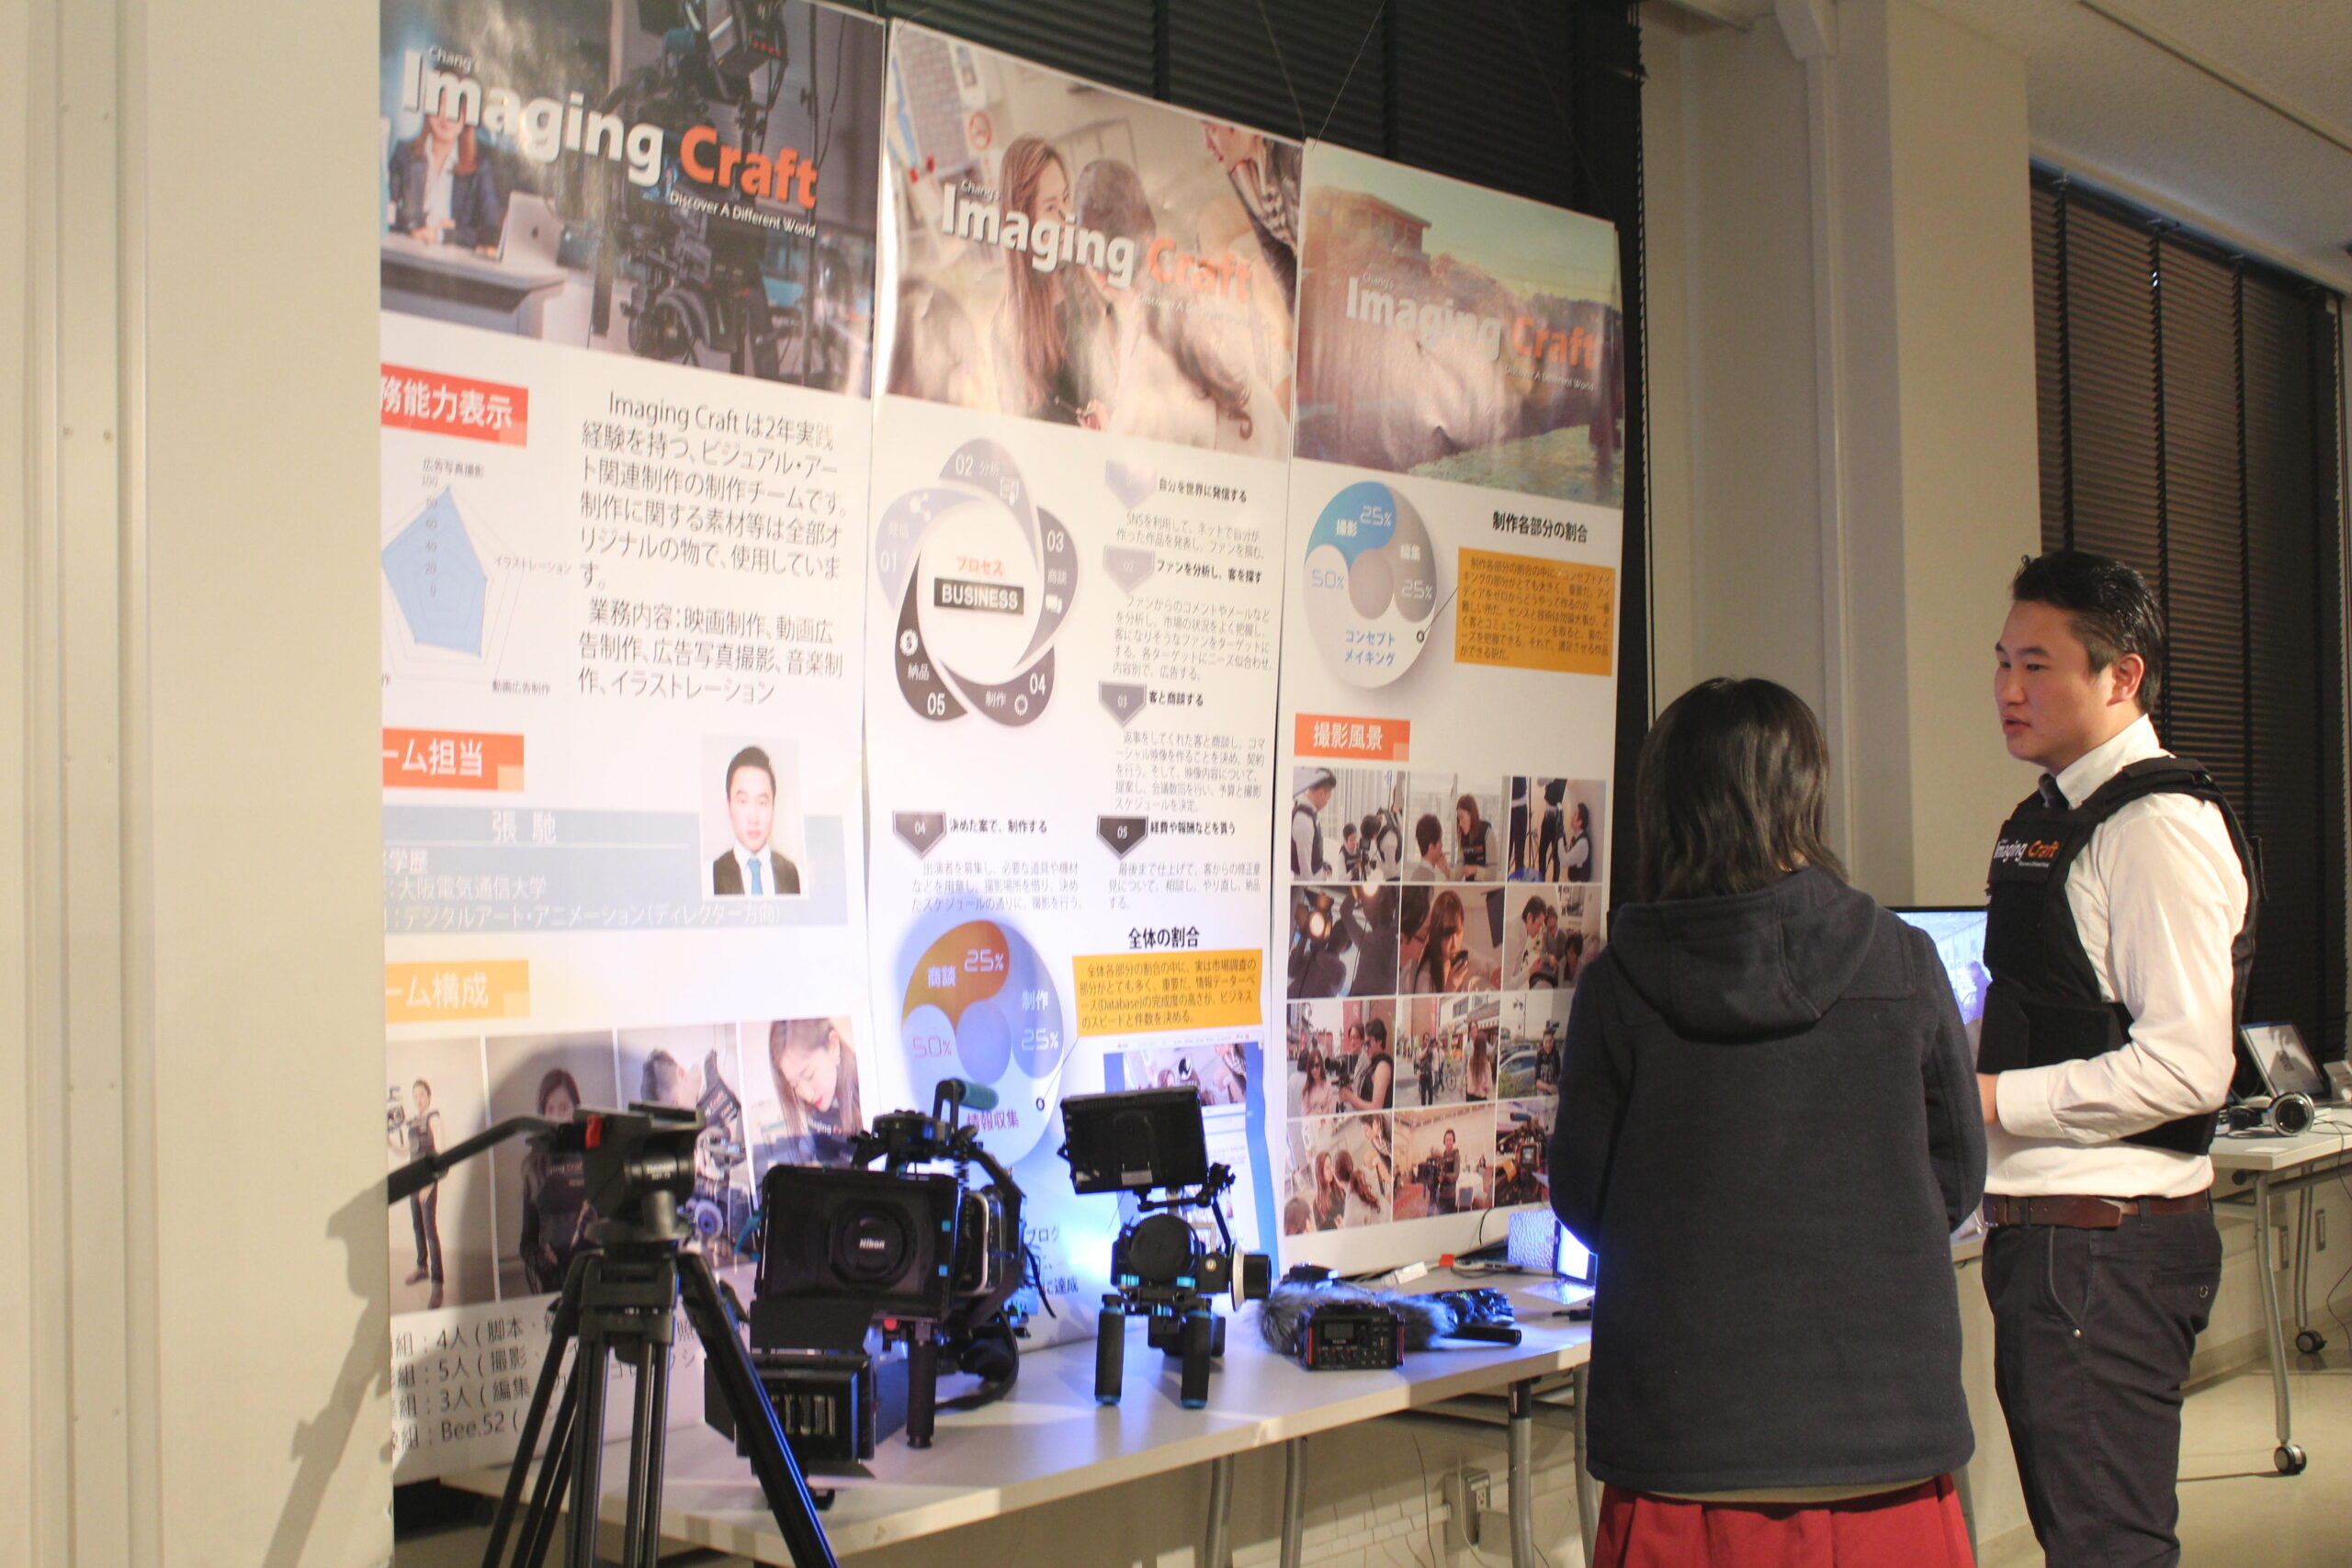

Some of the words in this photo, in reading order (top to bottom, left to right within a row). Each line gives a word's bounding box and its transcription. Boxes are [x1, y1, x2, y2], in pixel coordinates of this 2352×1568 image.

[402, 50, 665, 187] Imaging
[679, 124, 818, 209] Craft
[670, 189, 718, 215] Discover
[719, 203, 731, 219] A
[732, 205, 781, 231] Different
[782, 216, 817, 239] World
[941, 181, 1136, 290] Imaging
[1146, 235, 1251, 302] Craft
[1346, 276, 1502, 362] Imaging
[1511, 314, 1596, 370] Craft
[380, 374, 514, 430] 務能力表示
[609, 390, 690, 433] Imaging
[695, 404, 737, 434] Craft
[745, 411, 834, 451] は2年実践
[582, 419, 838, 479] 経験を持つ、ビジュアル・アー
[955, 453, 974, 477] 02
[583, 455, 846, 517] ト関連制作の制作チームです。
[1159, 477, 1248, 503] 自分を世界に発信する
[581, 491, 842, 548] 制作に関する素材等は全部オ
[1359, 504, 1393, 528] 25%
[1492, 510, 1589, 544] 制作各部分の割合
[581, 525, 841, 581] リジナルの物で、使用していま
[1046, 530, 1065, 553] 03
[879, 550, 899, 573] 01
[956, 555, 1004, 576] プロセス
[580, 560, 606, 591] す。
[1311, 568, 1345, 590] 50%
[941, 583, 1019, 610] BUSINESS
[1401, 580, 1433, 601] 25%
[1345, 629, 1396, 648] コンセプト
[579, 631, 843, 680] 告制作、広告写真撮影、音楽制
[1344, 649, 1396, 668] メイキング
[907, 661, 930, 682] 納品
[1028, 671, 1047, 695] 04
[578, 665, 775, 705] 作、イラストレーション
[926, 692, 946, 716] 05
[985, 691, 1007, 708] 制作
[1148, 691, 1204, 707] 客と商談する
[1312, 720, 1385, 750] 撮影風景
[382, 738, 483, 777] ーム担当
[914, 820, 926, 836] 04
[950, 818, 1047, 834] 決めた案で、制作する
[1116, 825, 1129, 840] 05
[1128, 925, 1201, 950] 全体の割合
[964, 948, 1004, 973] 25%
[927, 964, 956, 988] 商談
[385, 970, 489, 1008] ーム構成
[1021, 988, 1049, 1011] 制作
[912, 1035, 953, 1059] 50%
[1021, 1027, 1059, 1052] 25%
[967, 1109, 1020, 1133] 情報収集
[859, 1237, 886, 1251] Nikon
